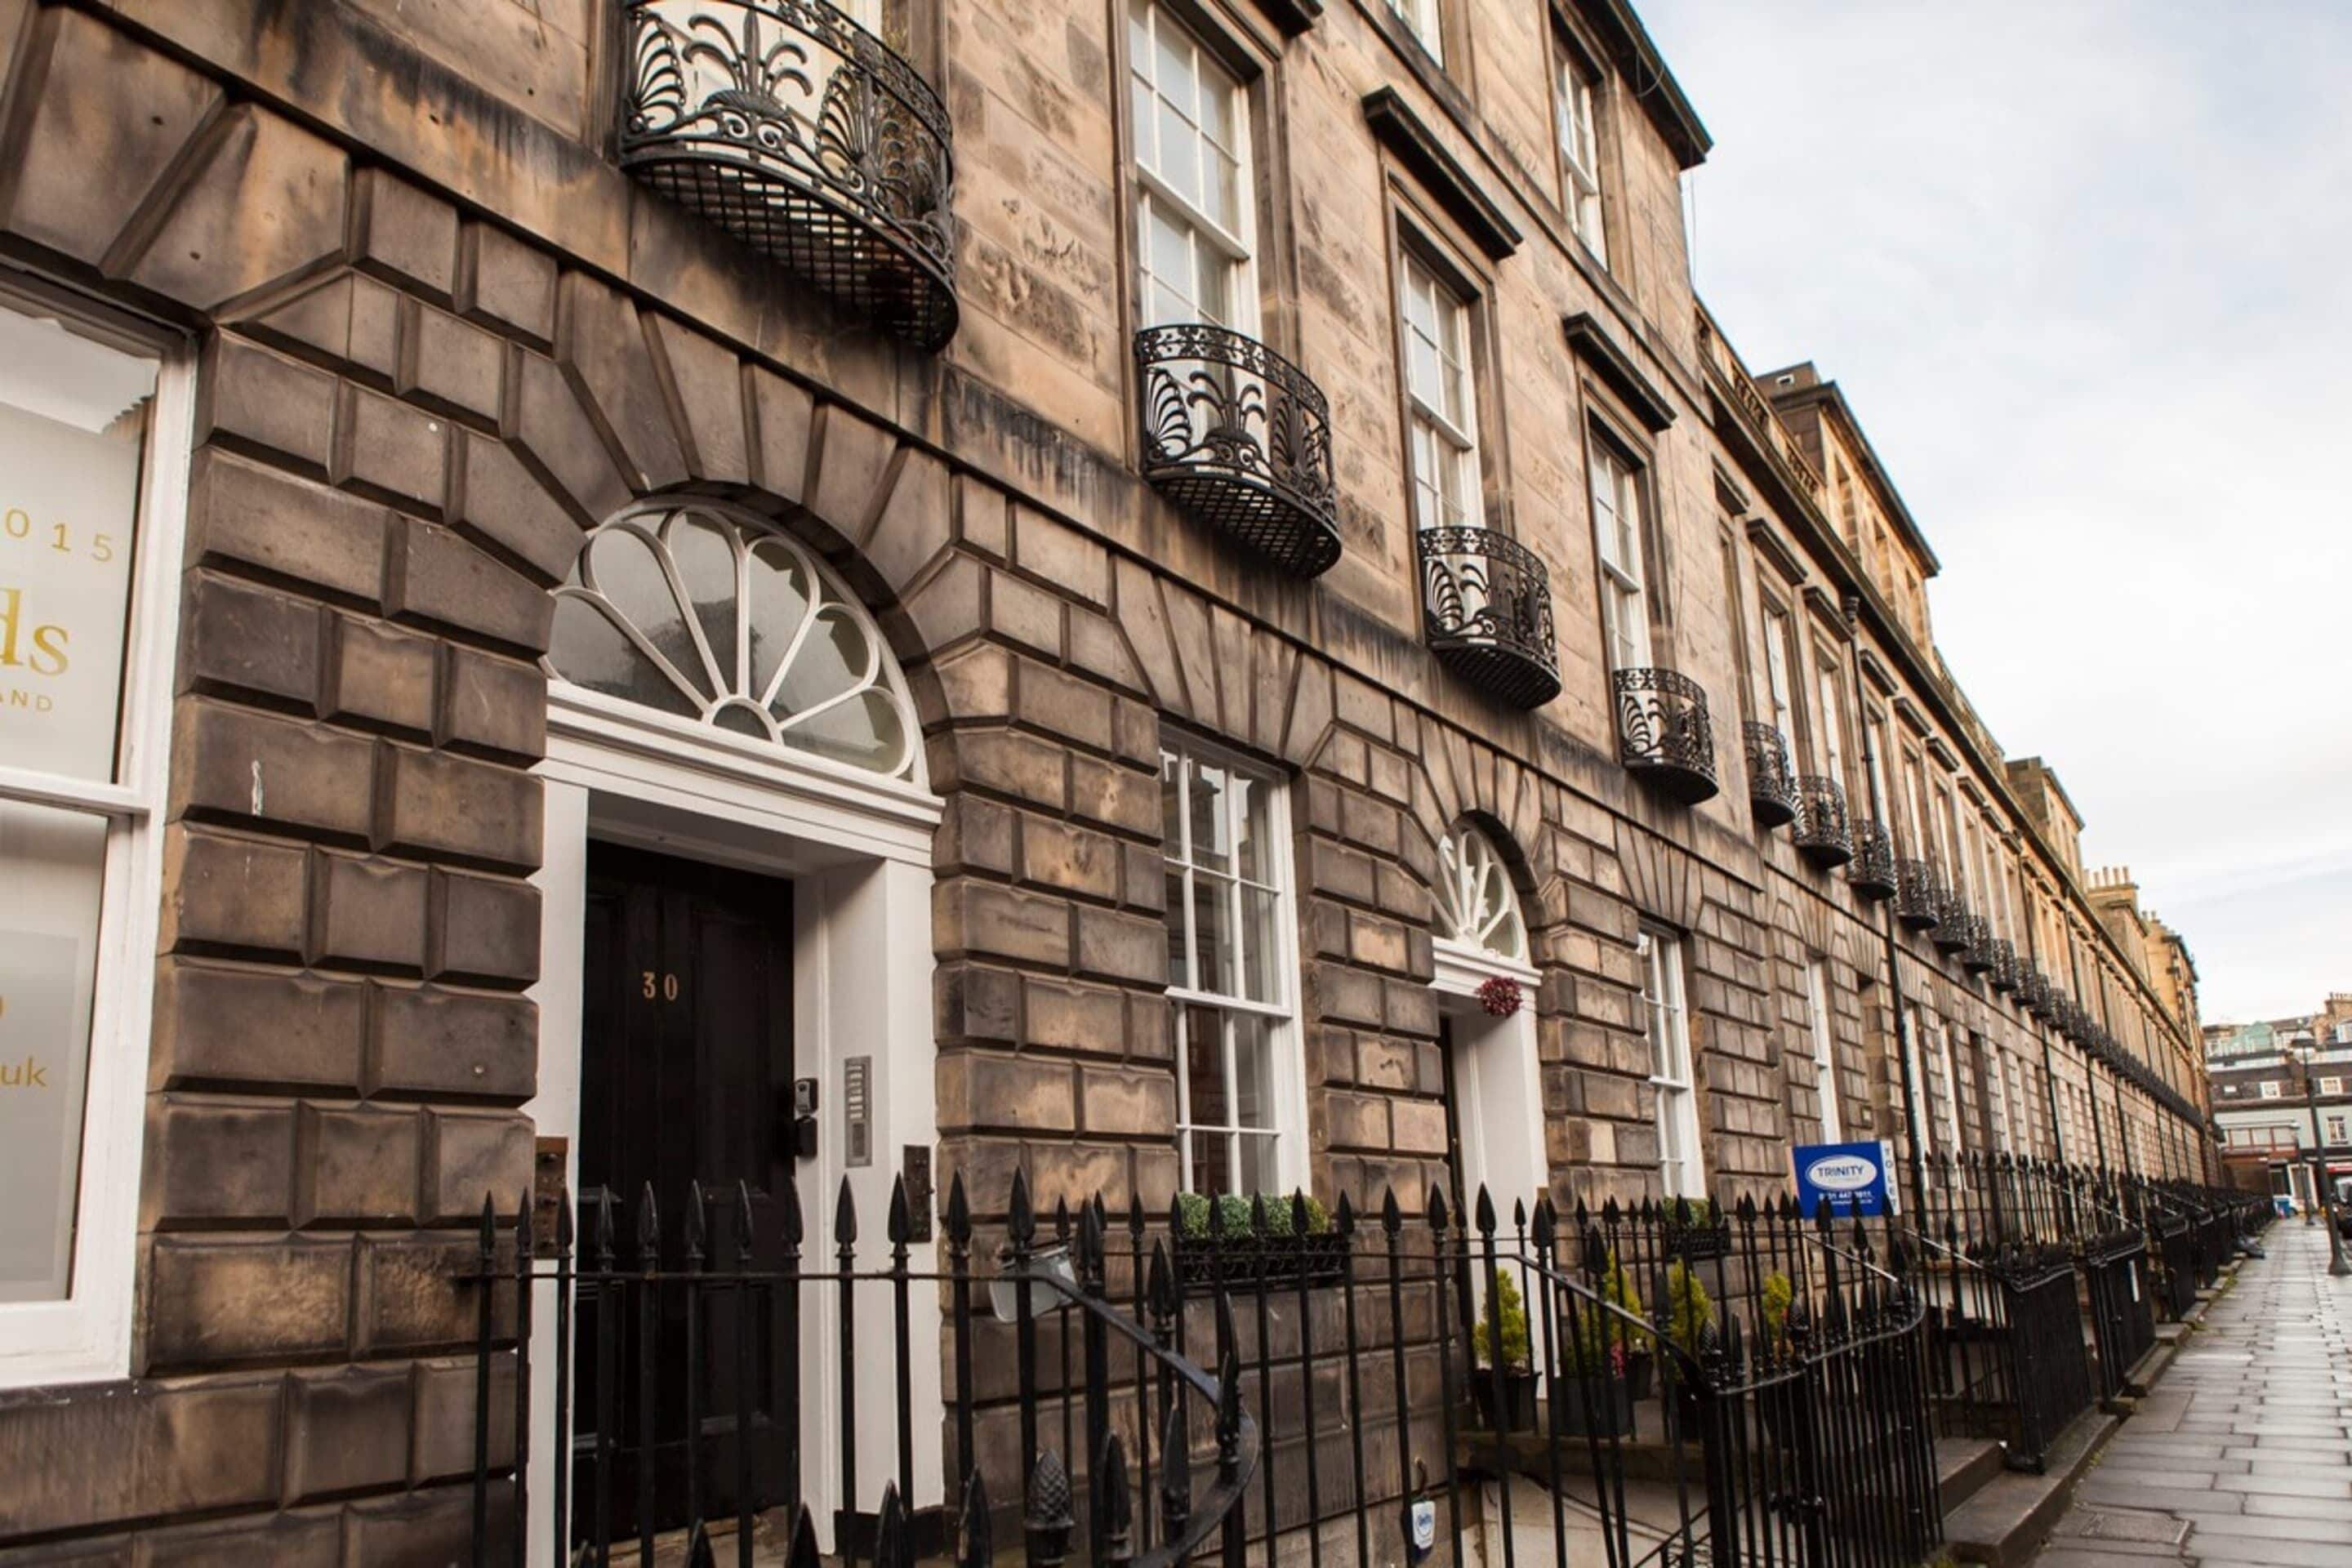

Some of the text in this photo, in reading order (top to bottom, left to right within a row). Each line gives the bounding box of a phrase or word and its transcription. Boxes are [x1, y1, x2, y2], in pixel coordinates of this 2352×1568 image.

[0, 689, 53, 711] ND
[643, 971, 678, 1001] 30
[1816, 1165, 1865, 1178] TRINITY
